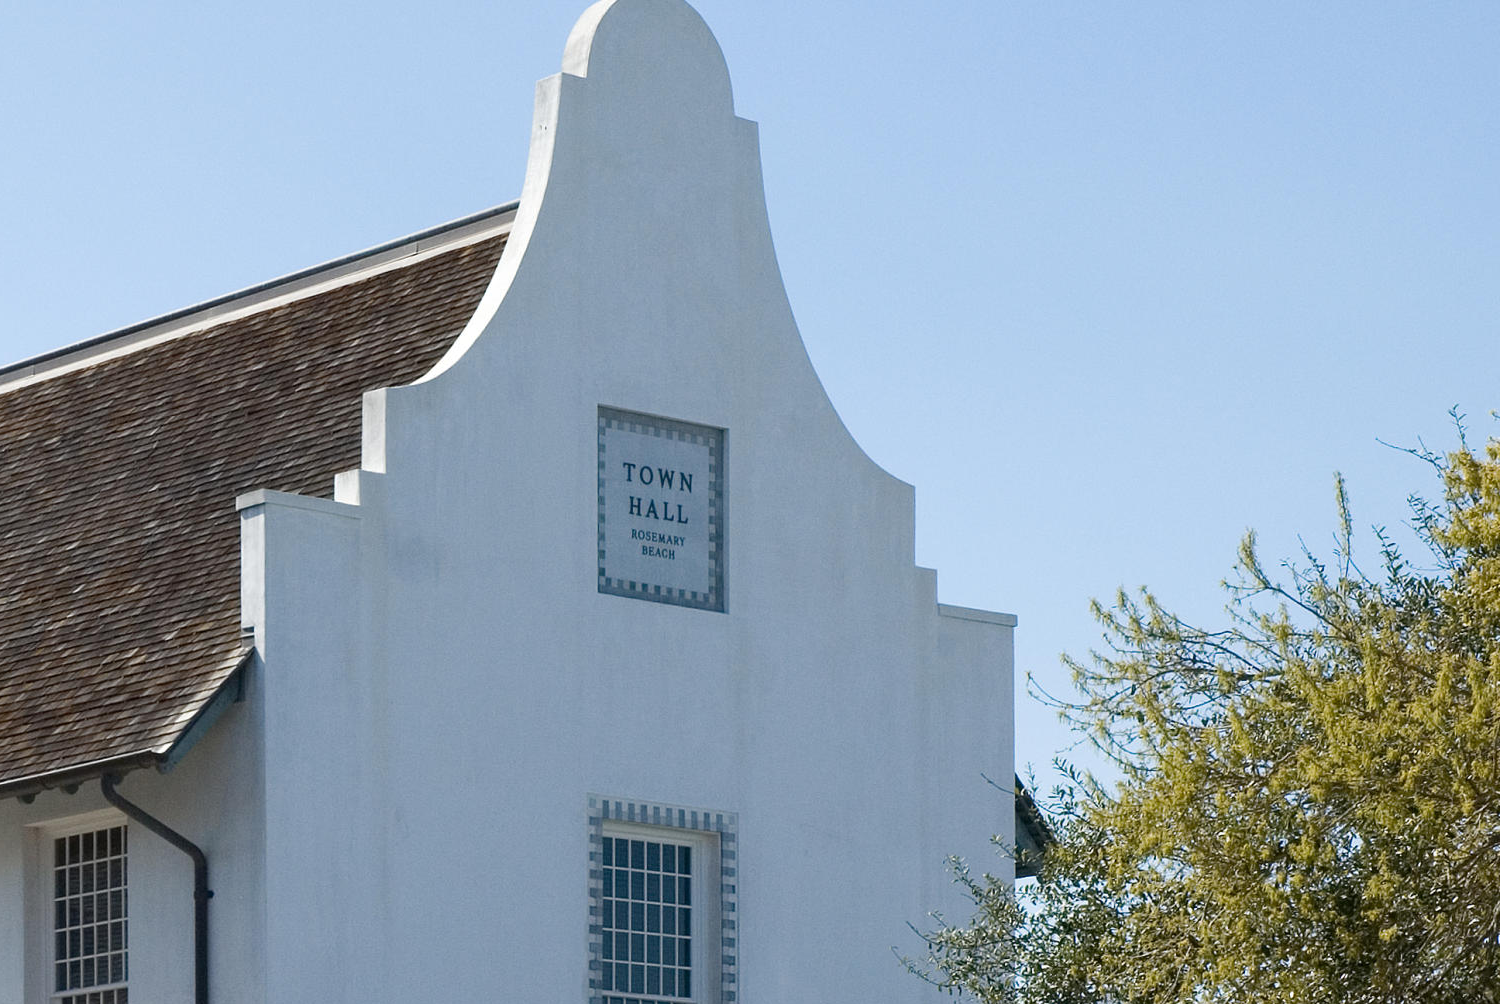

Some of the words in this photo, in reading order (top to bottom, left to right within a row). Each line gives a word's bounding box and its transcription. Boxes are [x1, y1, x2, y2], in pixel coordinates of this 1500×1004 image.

[623, 462, 693, 493] TOWN
[629, 496, 689, 524] HALL
[631, 529, 685, 546] ROSEMARY
[642, 546, 675, 560] BEACH
